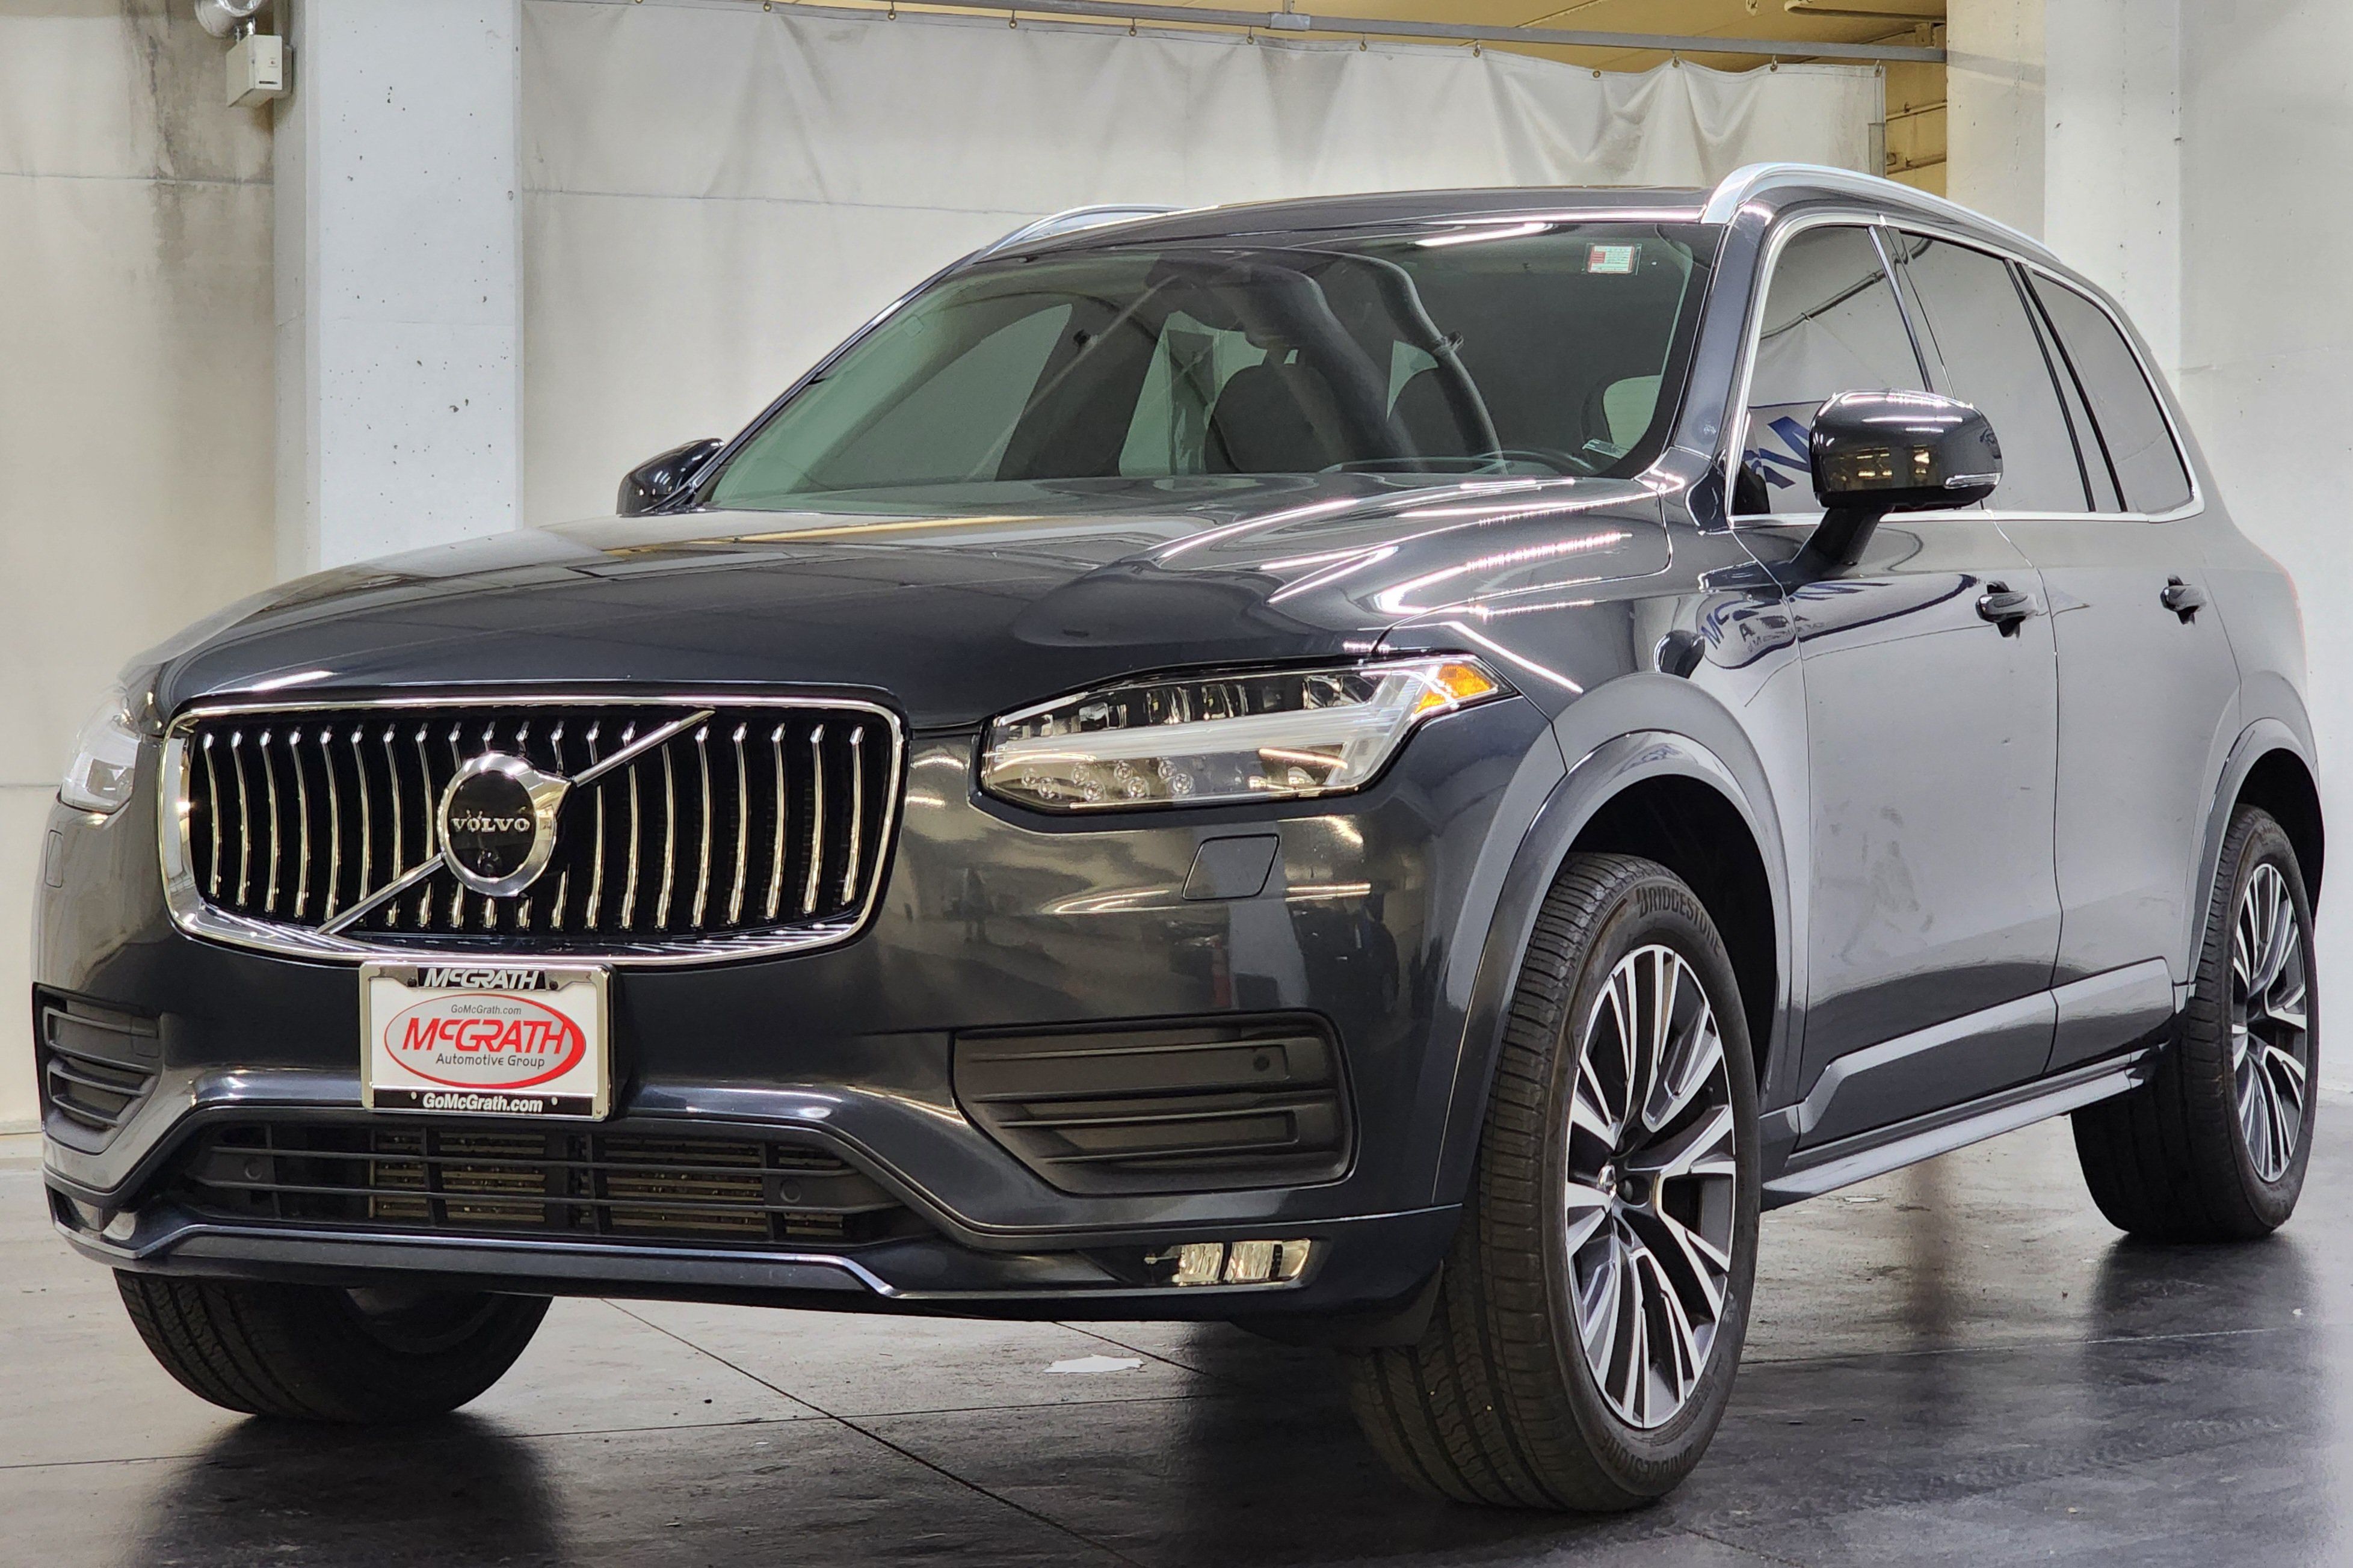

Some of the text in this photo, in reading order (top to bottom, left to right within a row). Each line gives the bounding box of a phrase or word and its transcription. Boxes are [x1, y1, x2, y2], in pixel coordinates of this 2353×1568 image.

[451, 818, 531, 832] VOLVO
[1636, 886, 1722, 956] BRIDGESTONE
[451, 1004, 522, 1015] GoMcGrath.com
[436, 1053, 545, 1070] Automotive Group
[422, 1092, 543, 1113] GoMcGrath.com
